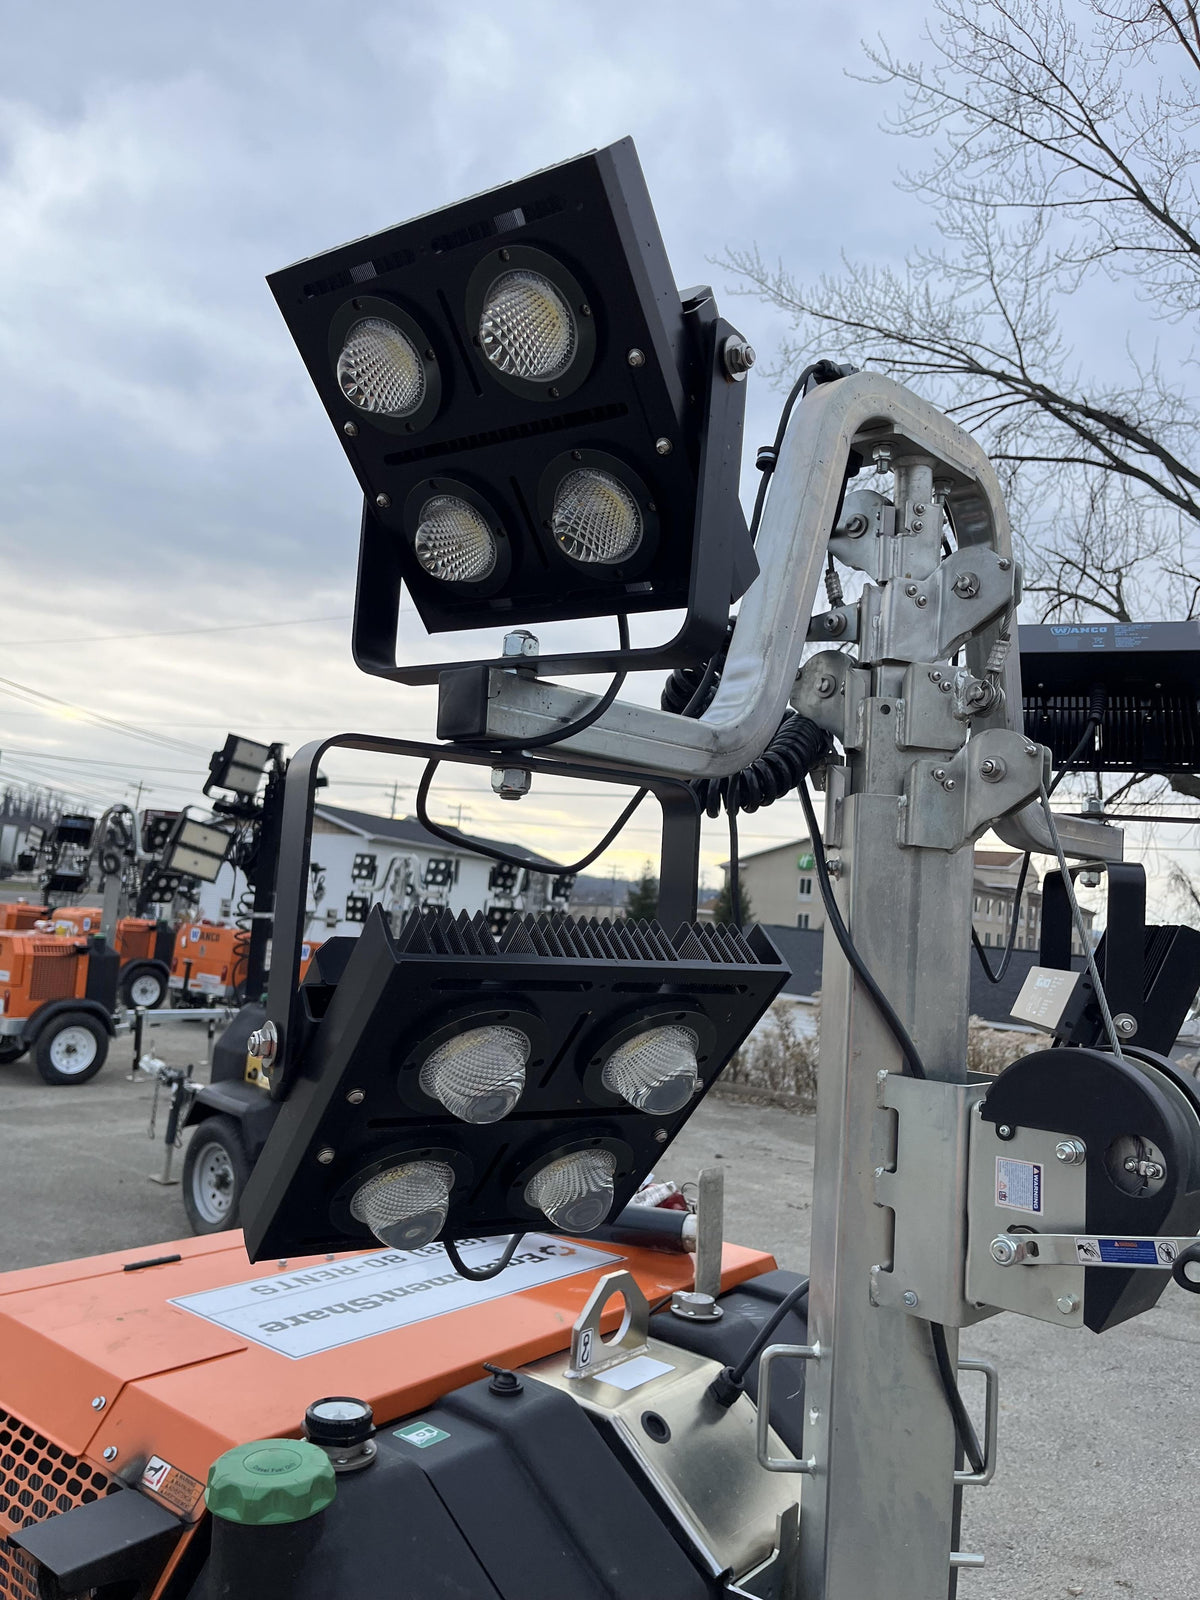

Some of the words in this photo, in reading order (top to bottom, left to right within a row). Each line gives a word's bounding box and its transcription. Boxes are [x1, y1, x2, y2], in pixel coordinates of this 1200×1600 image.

[1050, 626, 1108, 636] WANCO
[250, 1254, 408, 1295] 80-RENTS
[258, 1252, 551, 1332] EqmentShare
